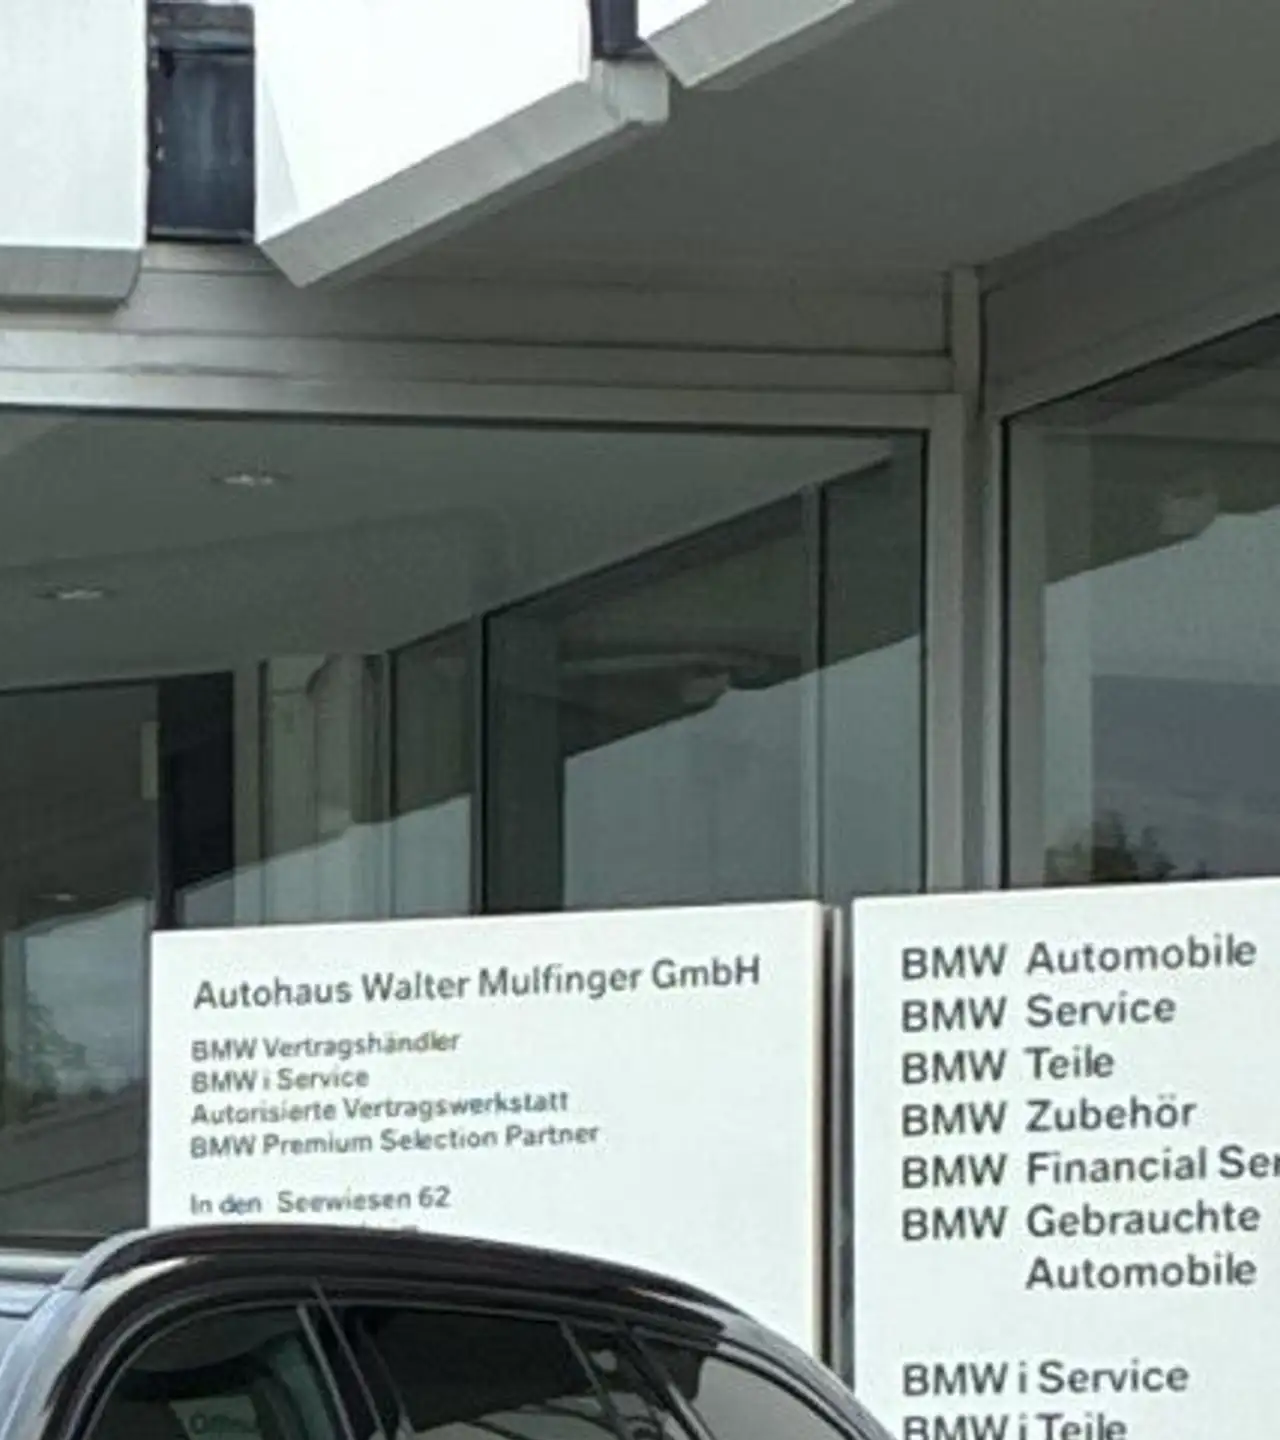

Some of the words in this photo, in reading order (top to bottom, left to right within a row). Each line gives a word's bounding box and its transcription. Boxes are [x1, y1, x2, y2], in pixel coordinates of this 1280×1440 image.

[901, 943, 1008, 981] BMW
[1025, 932, 1257, 976] Automobile
[193, 976, 353, 1010] Autohaus
[361, 971, 469, 1003] Walter
[478, 963, 643, 1001] Mulfinger
[651, 954, 761, 990] GmbH
[901, 996, 1008, 1033] BMW
[1026, 990, 1177, 1029] Service
[191, 1037, 258, 1063] BMW
[262, 1030, 461, 1062] Vertragshändler
[901, 1048, 1007, 1086] BMW
[1023, 1044, 1115, 1081] Teile
[191, 1070, 258, 1094] BMW
[262, 1070, 272, 1092] i
[276, 1067, 370, 1092] Service
[190, 1100, 337, 1126] Autorisierte
[341, 1091, 569, 1124] Vertragswerkstatt
[901, 1100, 1008, 1138] BMW
[1025, 1094, 1197, 1133] Zubehör
[189, 1134, 257, 1160] BMW
[262, 1132, 374, 1156] Premium
[379, 1127, 499, 1153] Selection
[504, 1123, 601, 1147] Partner
[901, 1153, 1008, 1190] BMW
[1027, 1145, 1207, 1186] Financial
[189, 1193, 213, 1216] In
[218, 1194, 262, 1216] den
[277, 1189, 412, 1214] Seewiesen
[417, 1184, 452, 1209] 62
[902, 1205, 1008, 1242] BMW
[1026, 1199, 1262, 1238] Gebrauchte
[1025, 1252, 1257, 1290] Automobile
[902, 1361, 1009, 1397] BMW
[1018, 1361, 1028, 1394] i
[1038, 1358, 1190, 1395] Service
